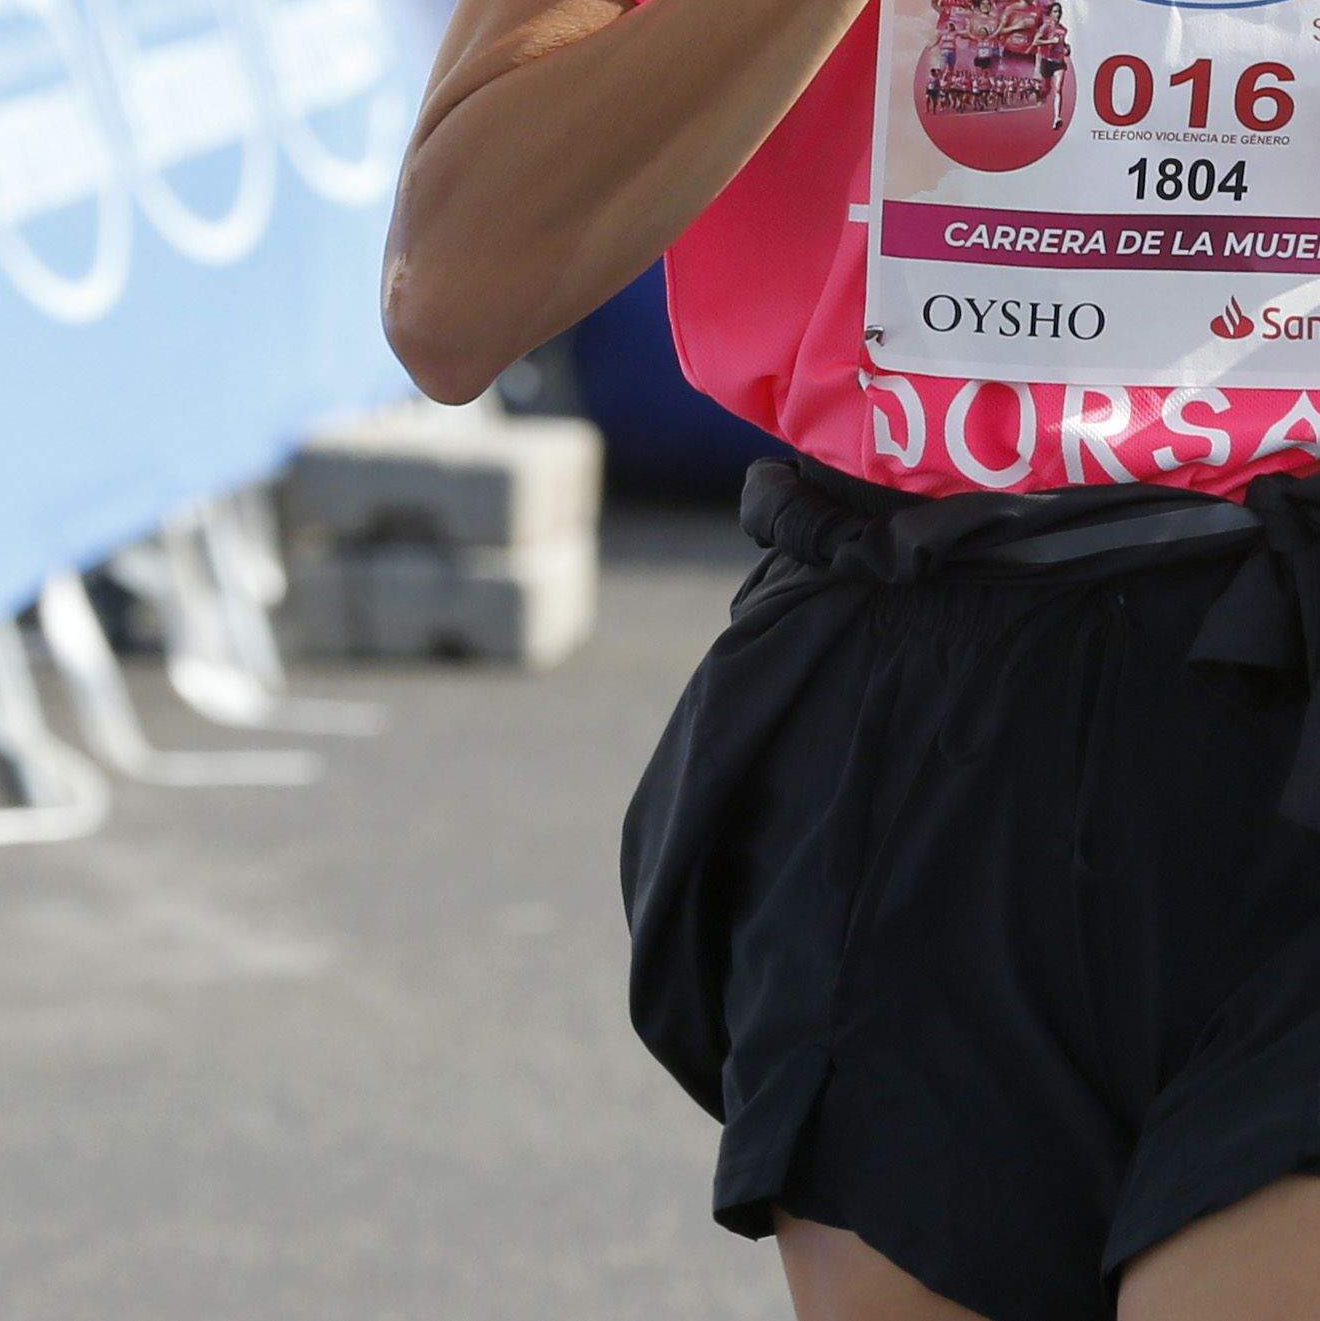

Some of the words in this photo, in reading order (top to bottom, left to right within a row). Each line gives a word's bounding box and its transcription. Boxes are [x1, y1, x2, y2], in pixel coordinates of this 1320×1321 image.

[1092, 53, 1297, 133] 016
[1091, 128, 1153, 142] TELÉFONO
[1156, 130, 1219, 144] VIOLENCIA
[1221, 134, 1237, 145] DE
[1240, 132, 1290, 147] GÉNERO
[1127, 157, 1249, 202] 1804
[943, 221, 1108, 255] CARRERA
[1115, 229, 1163, 256] DE
[1170, 231, 1215, 257] LA
[922, 293, 1106, 341] OYSHO
